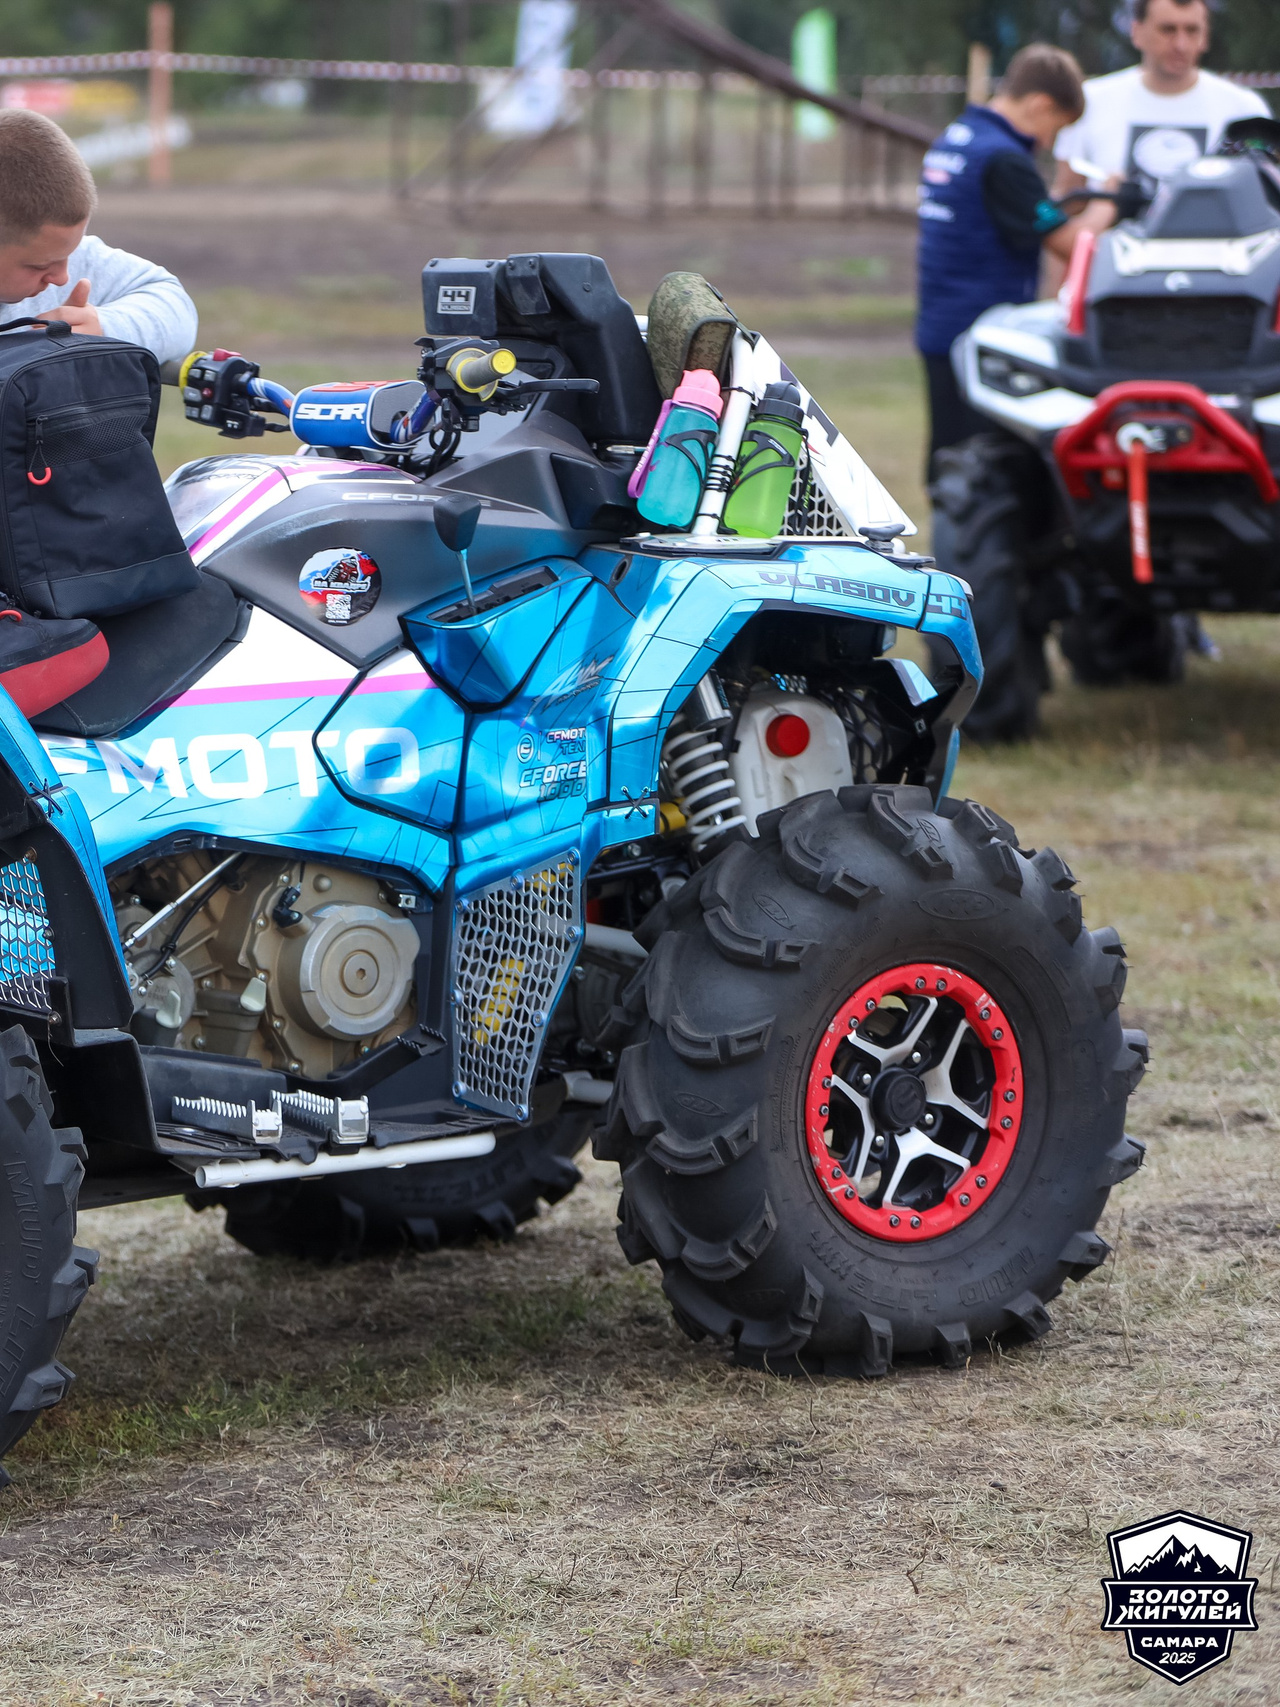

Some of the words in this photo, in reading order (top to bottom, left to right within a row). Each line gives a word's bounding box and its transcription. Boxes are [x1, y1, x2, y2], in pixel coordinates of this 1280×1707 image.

[442, 290, 471, 302] 44
[294, 403, 367, 421] SCAR
[342, 492, 491, 508] CFORE
[759, 572, 915, 608] VLASOV
[923, 592, 967, 621] 44
[546, 727, 587, 744] CFMOT
[39, 727, 421, 799] FMOTO
[519, 759, 587, 788] CFORCE
[537, 778, 587, 802] 1000
